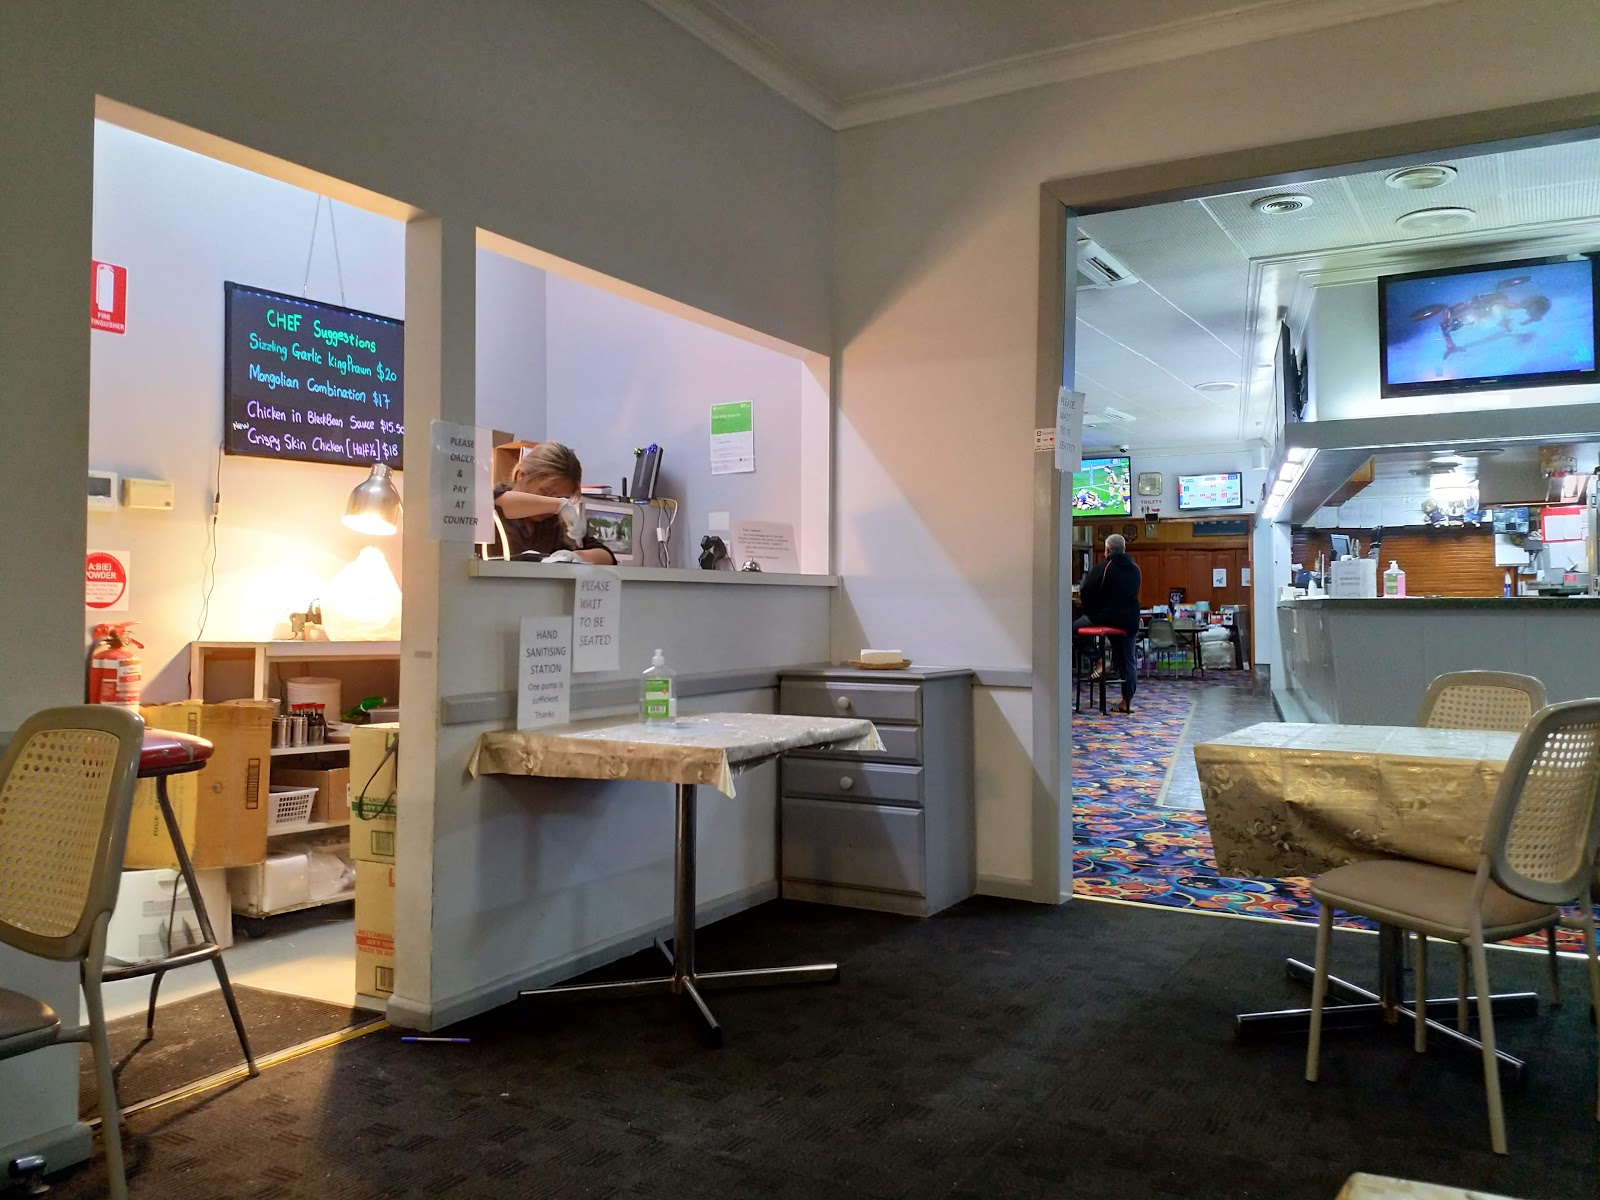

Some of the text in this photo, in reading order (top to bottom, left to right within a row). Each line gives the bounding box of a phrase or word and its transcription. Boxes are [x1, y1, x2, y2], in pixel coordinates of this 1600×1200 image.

[266, 309, 377, 353] CHEF Suggestions
[249, 332, 288, 361] Sizzling
[292, 342, 322, 365] Garlic
[376, 361, 397, 383] $20
[249, 363, 391, 410] Mongolian Combination $17
[247, 400, 287, 422] Chicken
[292, 409, 302, 424] in
[350, 415, 375, 430] Sauce
[247, 427, 281, 451] Crispy
[283, 433, 307, 451] Skin
[312, 436, 345, 454] Chicken
[382, 442, 399, 461] $18
[450, 437, 475, 449] PLEASE
[456, 469, 463, 478] &
[452, 484, 468, 493] PAY
[454, 501, 466, 509] AT
[443, 515, 479, 526] COUNTER
[581, 580, 611, 592] PLEASE
[580, 598, 603, 609] WAIT
[580, 616, 606, 628] TO BE
[536, 629, 558, 640] HAND
[578, 634, 612, 647] SEATED
[526, 646, 567, 658] SANITISING
[530, 664, 562, 675] STATION
[528, 683, 540, 692] One
